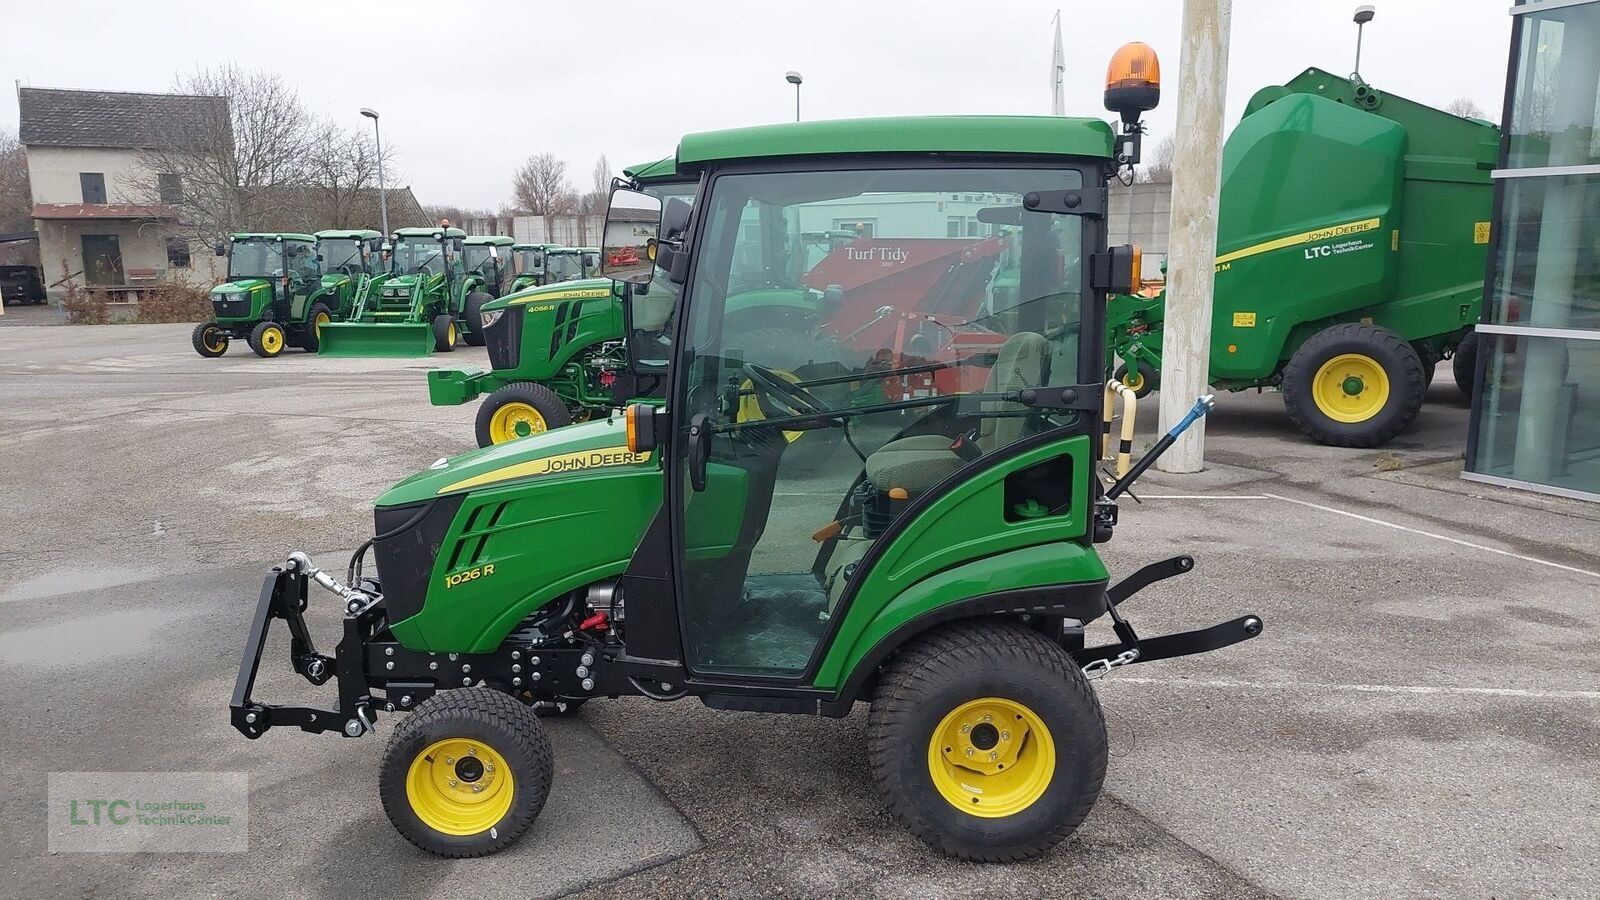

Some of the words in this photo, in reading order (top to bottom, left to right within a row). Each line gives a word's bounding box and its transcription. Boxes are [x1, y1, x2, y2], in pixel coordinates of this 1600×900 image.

[1306, 230, 1333, 241] JOHN
[1335, 223, 1370, 235] DEERE
[845, 247, 876, 260] Turf
[878, 247, 910, 264] Tidy
[1304, 245, 1331, 259] LTC
[541, 457, 586, 473] JOHN
[590, 452, 644, 466] DEERE
[445, 568, 481, 589] 1026
[483, 564, 495, 576] R
